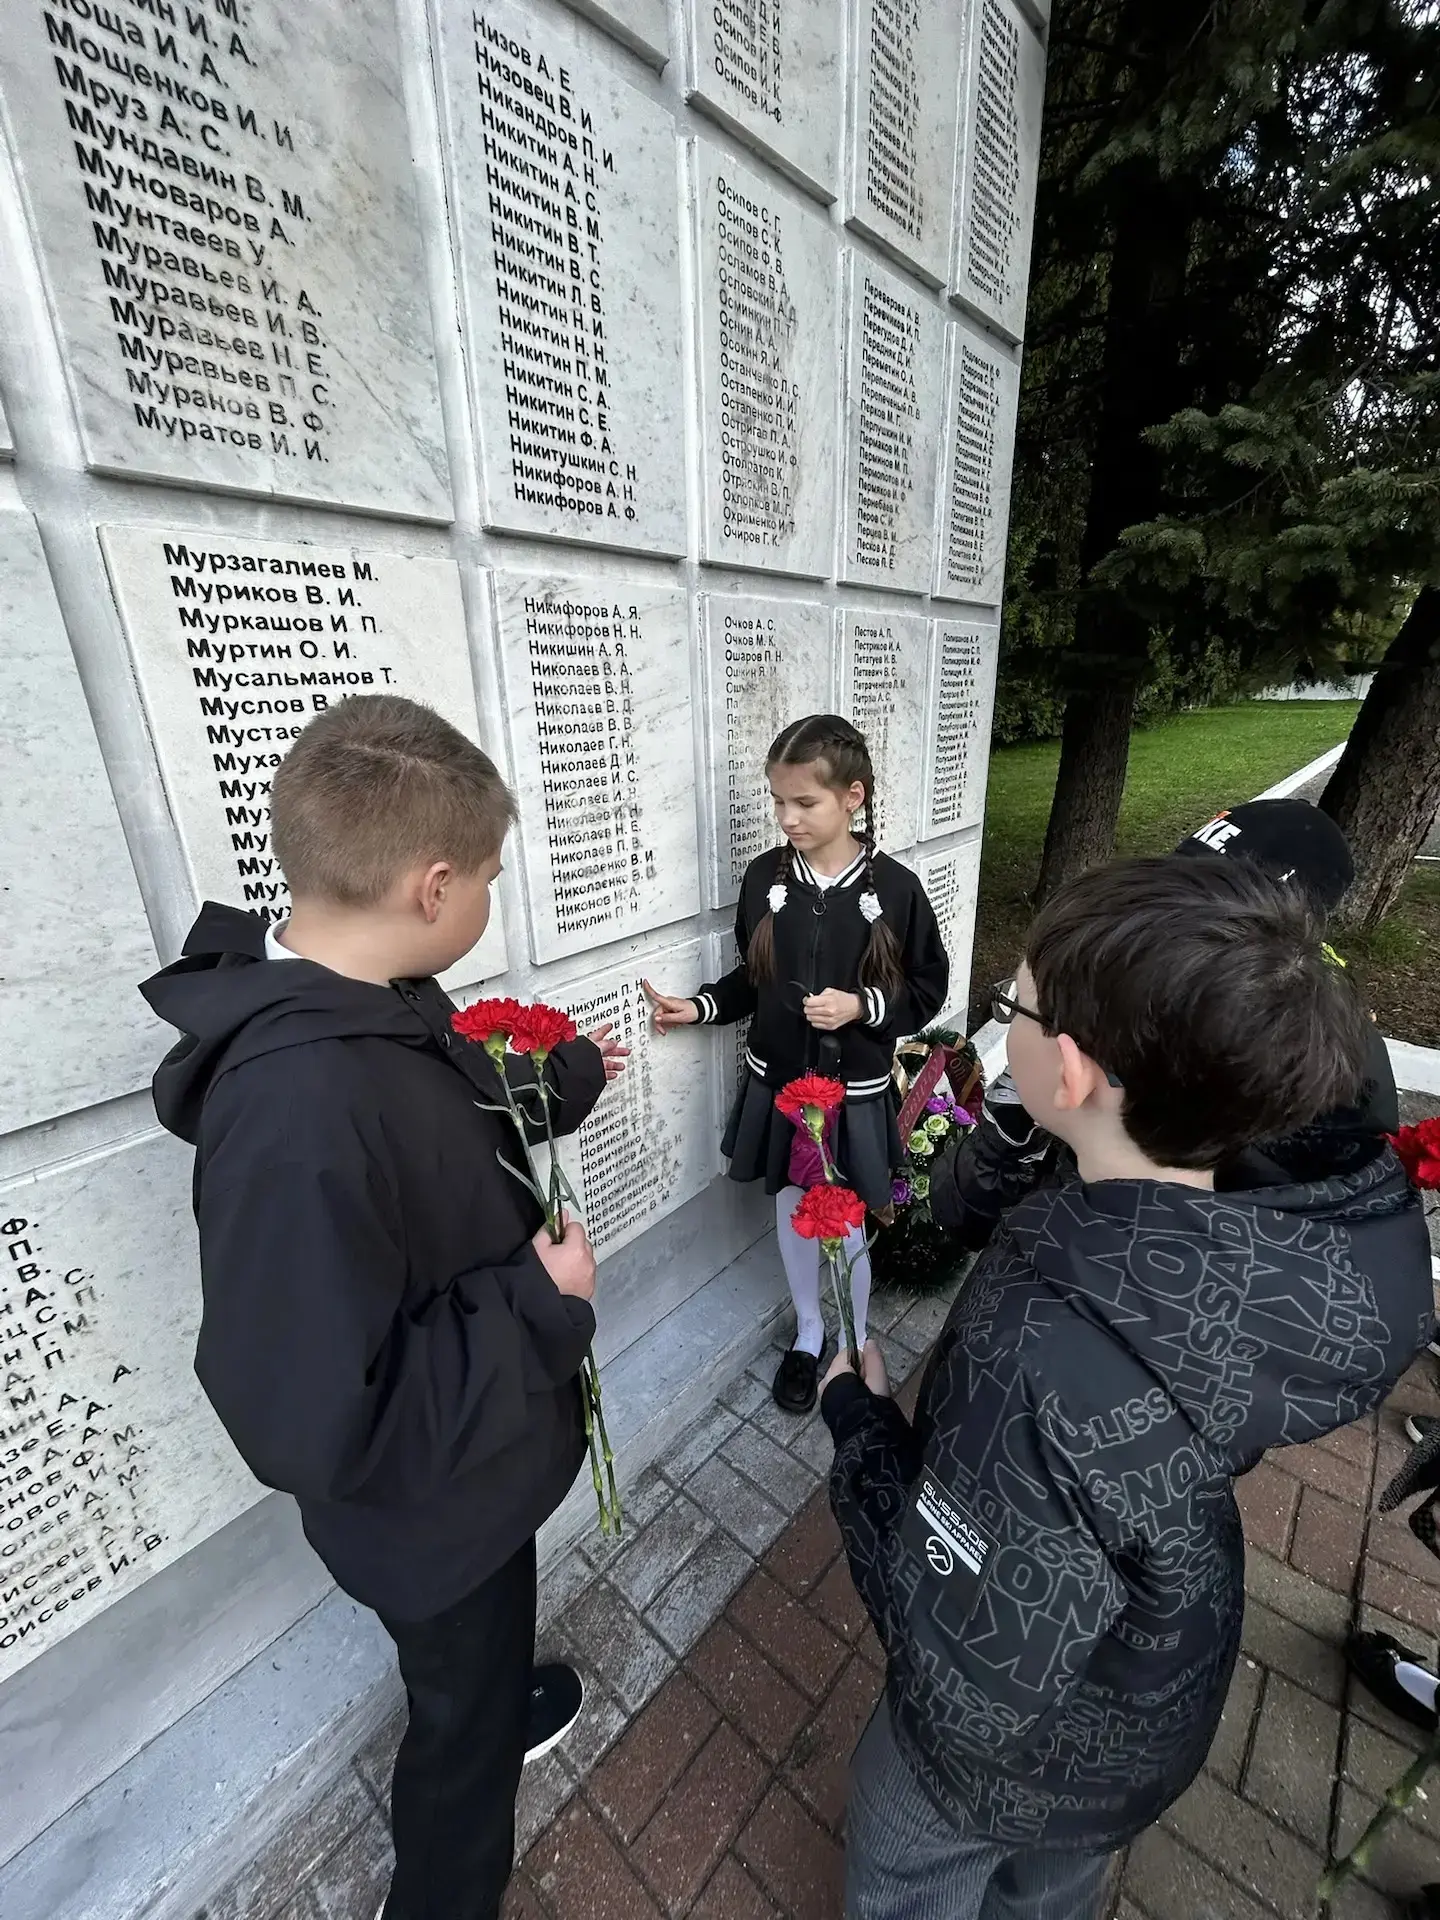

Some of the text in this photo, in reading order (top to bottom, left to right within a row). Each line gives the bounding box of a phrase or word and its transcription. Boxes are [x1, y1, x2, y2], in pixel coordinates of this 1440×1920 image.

[154, 26, 189, 70] И.
[200, 53, 229, 89] А.
[185, 7, 219, 48] И.
[229, 32, 258, 67] А.
[472, 9, 574, 95] Низов А. Е.
[44, 11, 229, 122] Мощенков
[238, 105, 267, 141] И.
[475, 41, 596, 134] Низовец В. И.
[715, 57, 757, 104] Осипов
[54, 56, 230, 157] Мруз А. С.
[478, 72, 618, 174] Никандров П. И.
[64, 99, 312, 223] Мундавин В. М.
[481, 103, 599, 189] Никитин А. Н.
[73, 141, 296, 248] Муноваров А.
[483, 133, 601, 215] Никитин А. С.
[84, 182, 240, 259] Мунтаеев
[486, 163, 604, 243] Никитин В. М.
[718, 177, 781, 233] Осипов С. Г.
[718, 200, 771, 248] Осипов С.
[489, 193, 601, 265] Никитин В. Т.
[718, 222, 785, 277] Осипов Ф. В.
[93, 221, 323, 317] Муравьев И. А.
[719, 245, 766, 284] Осламов
[101, 260, 327, 348] Муравьев И. В.
[110, 297, 331, 379] Муравьев Н. Е.
[501, 332, 611, 387] Никитин П. М.
[118, 334, 270, 394] Муравьев
[312, 384, 336, 408] С.
[721, 373, 773, 406] Остапенко
[126, 368, 331, 437] Муранов В. Ф.
[506, 385, 611, 432] Никитин С. Е.
[861, 399, 885, 420] Перков
[134, 404, 329, 463] Муратов И. И.
[510, 434, 639, 482] Никитушкин С. Н.
[515, 482, 639, 522] Никифоров А. Ф.
[724, 525, 761, 544] Очиров
[163, 543, 379, 582] Мурзагалиев М.
[170, 576, 362, 607] Муриков В. И.
[525, 597, 641, 620] Никифоров А. Я.
[178, 607, 323, 634] Муркашов
[361, 616, 383, 633] П.
[527, 619, 642, 640] Никифоров Н. Н.
[725, 616, 776, 631] Очков А. С.
[855, 626, 877, 638] Пестов
[186, 638, 357, 663] Муртин О. И.
[529, 640, 628, 657] Никишин А. Я.
[531, 661, 633, 676] Николаев В. А.
[725, 649, 762, 663] Ошаров
[192, 667, 397, 692] Мусальманов Т.
[200, 697, 305, 720] Муслов
[538, 717, 635, 736] Николаев В. В.
[206, 725, 302, 747] Мустае
[213, 752, 281, 774] Муха
[543, 770, 639, 793] Николаев И. С.
[567, 990, 618, 1017] Никулин
[621, 984, 632, 996] П.
[578, 1005, 619, 1028] овиков
[582, 1135, 641, 1175] Новиченко
[584, 1151, 636, 1188] Новичков
[919, 1492, 984, 1564] ALPINE SKI APPAREL
[923, 1480, 989, 1555] GLISSADE
[0, 1532, 170, 1649] оисеев И. В.
